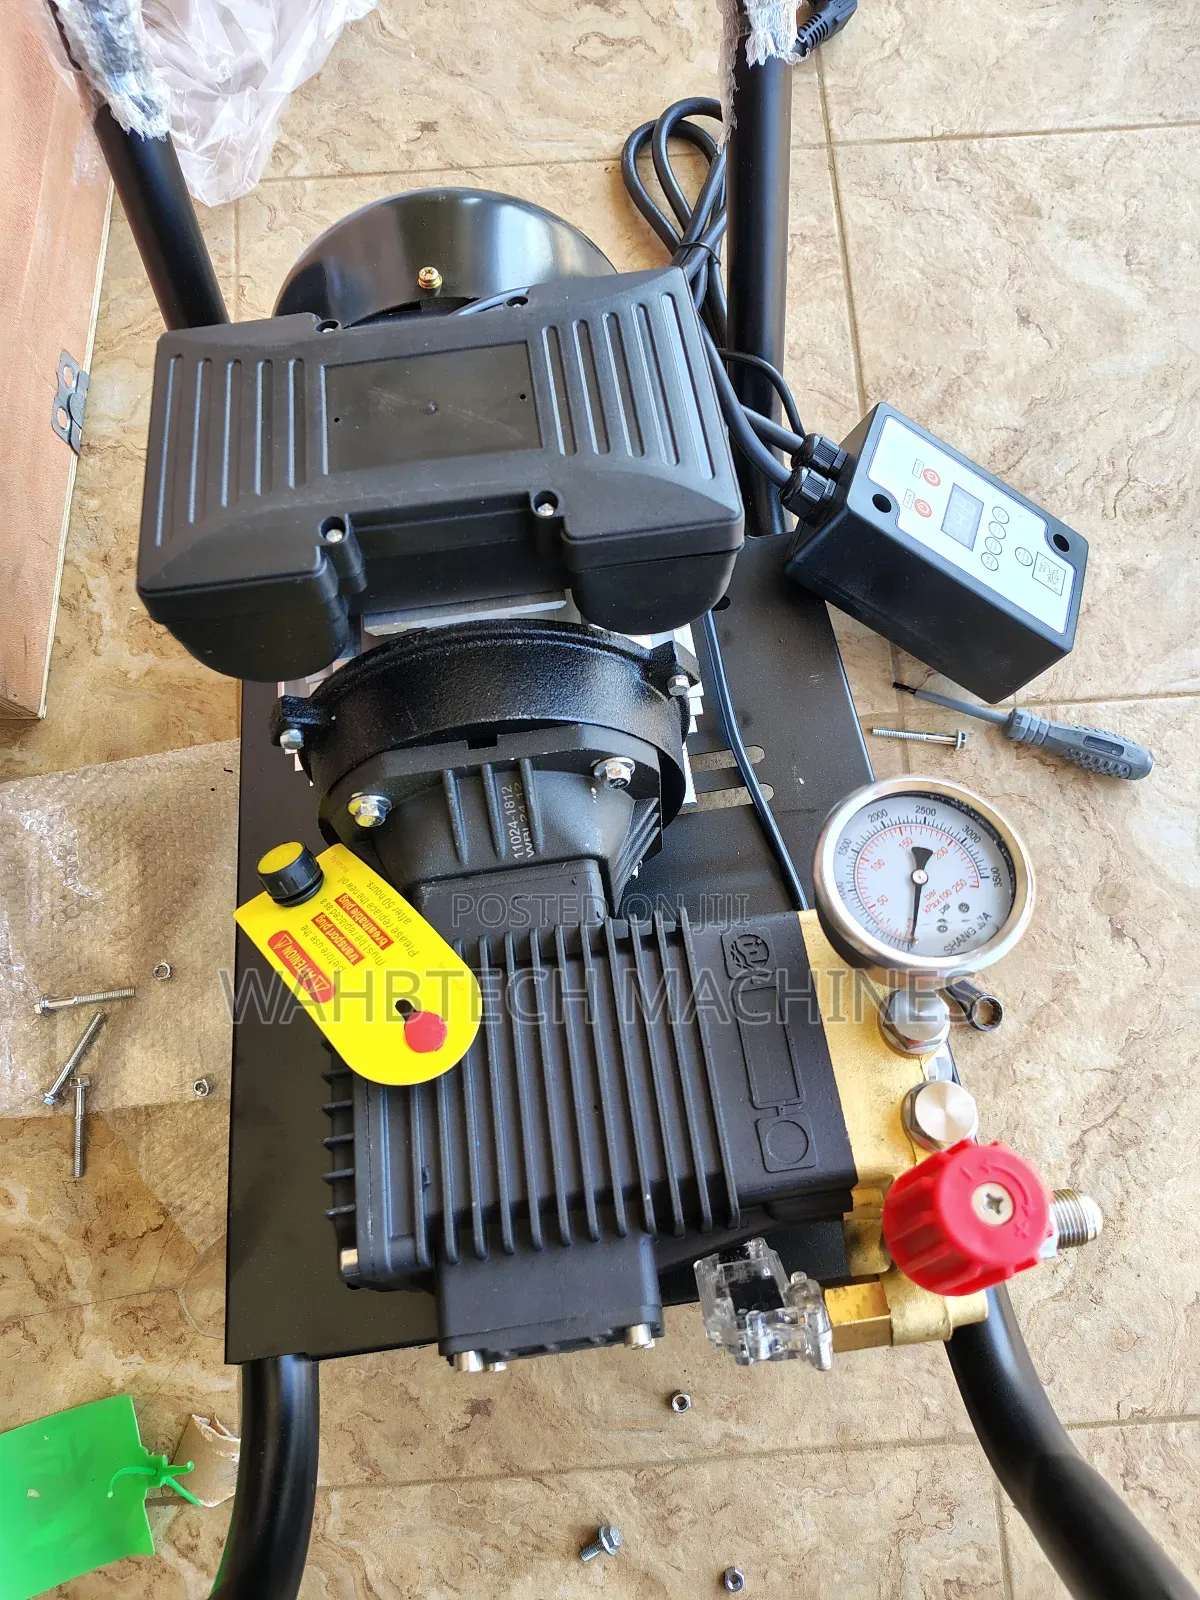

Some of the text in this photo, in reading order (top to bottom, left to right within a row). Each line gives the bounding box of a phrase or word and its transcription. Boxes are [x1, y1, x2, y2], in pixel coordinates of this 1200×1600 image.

[867, 808, 889, 824] 2000
[915, 805, 937, 817] 2500
[501, 784, 524, 859] 11024-1812
[961, 824, 982, 844] 3000
[837, 838, 853, 857] 1500
[898, 836, 913, 850] 150
[933, 846, 949, 861] 200
[870, 859, 885, 873] 100
[951, 878, 967, 894] 250
[339, 896, 356, 910] plug
[381, 897, 396, 910] 50
[876, 894, 889, 906] 50
[328, 908, 358, 936] replaced
[337, 877, 419, 957] Please replace the new oil
[392, 907, 412, 924] after
[351, 908, 389, 947] breathable
[315, 914, 359, 962] transport plug
[355, 935, 367, 947] be
[943, 926, 977, 956] SHANG
[320, 947, 345, 974] Before
[363, 944, 385, 966] must
